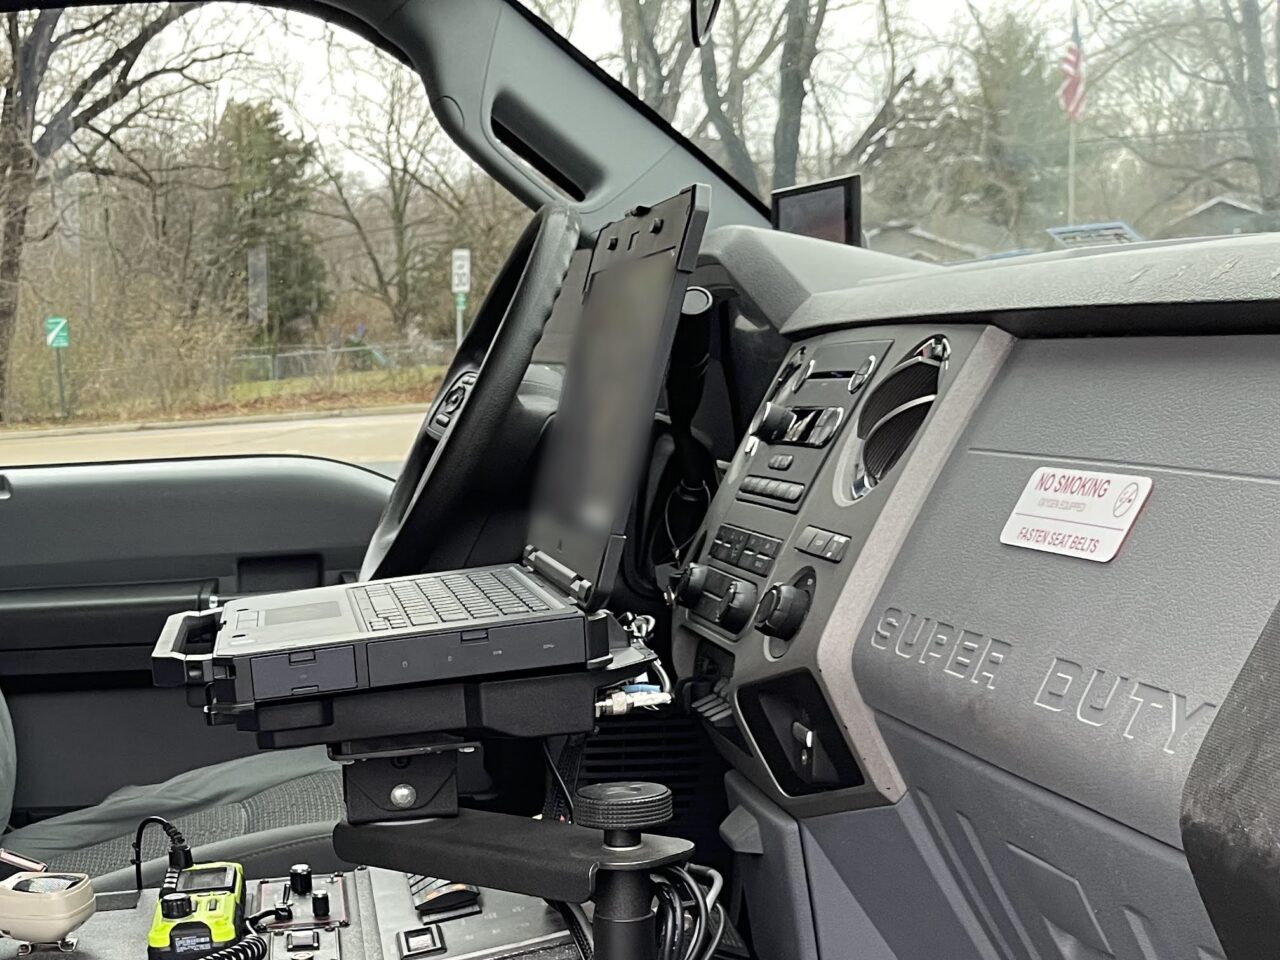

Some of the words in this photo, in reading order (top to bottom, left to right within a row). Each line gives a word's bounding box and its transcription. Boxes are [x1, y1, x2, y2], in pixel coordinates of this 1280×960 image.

[1035, 473, 1056, 492] NO
[1054, 475, 1111, 498] SMOKING
[1017, 527, 1050, 544] FASTEN
[1047, 532, 1073, 548] SEAT
[1069, 535, 1100, 553] BELTS
[870, 606, 1014, 690] SUPER
[1033, 656, 1217, 755] DUTY
